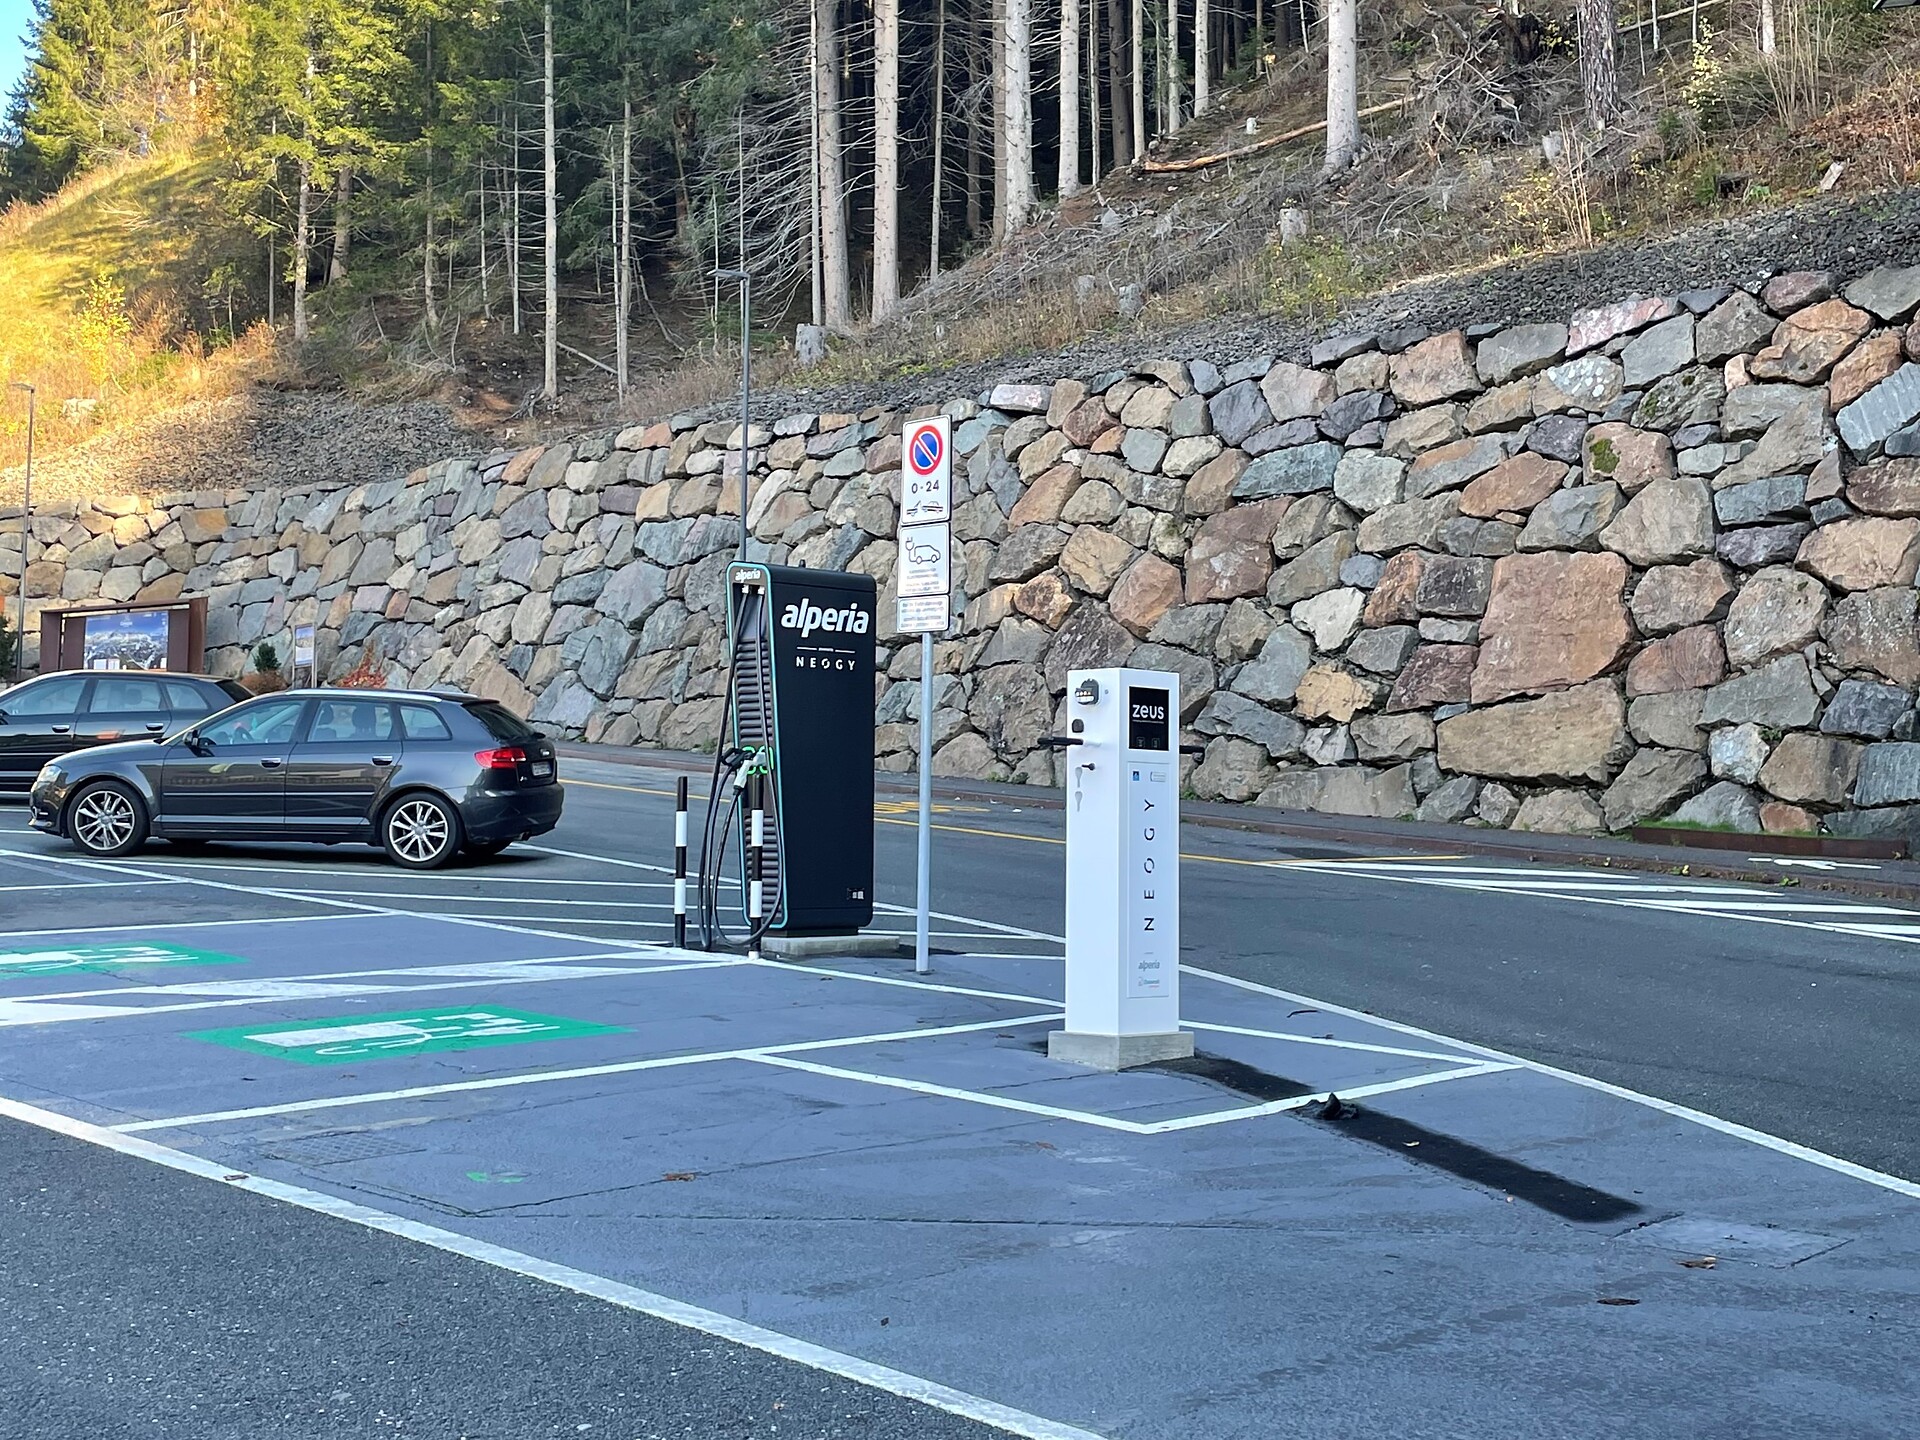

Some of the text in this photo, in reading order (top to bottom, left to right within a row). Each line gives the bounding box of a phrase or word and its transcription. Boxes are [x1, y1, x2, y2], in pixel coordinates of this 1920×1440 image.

[735, 569, 761, 583] alperia
[781, 598, 870, 638] alperia
[795, 656, 856, 671] NEOGY
[1132, 704, 1165, 720] zeus
[1144, 799, 1155, 931] NEOGY
[1138, 960, 1161, 971] alperia
